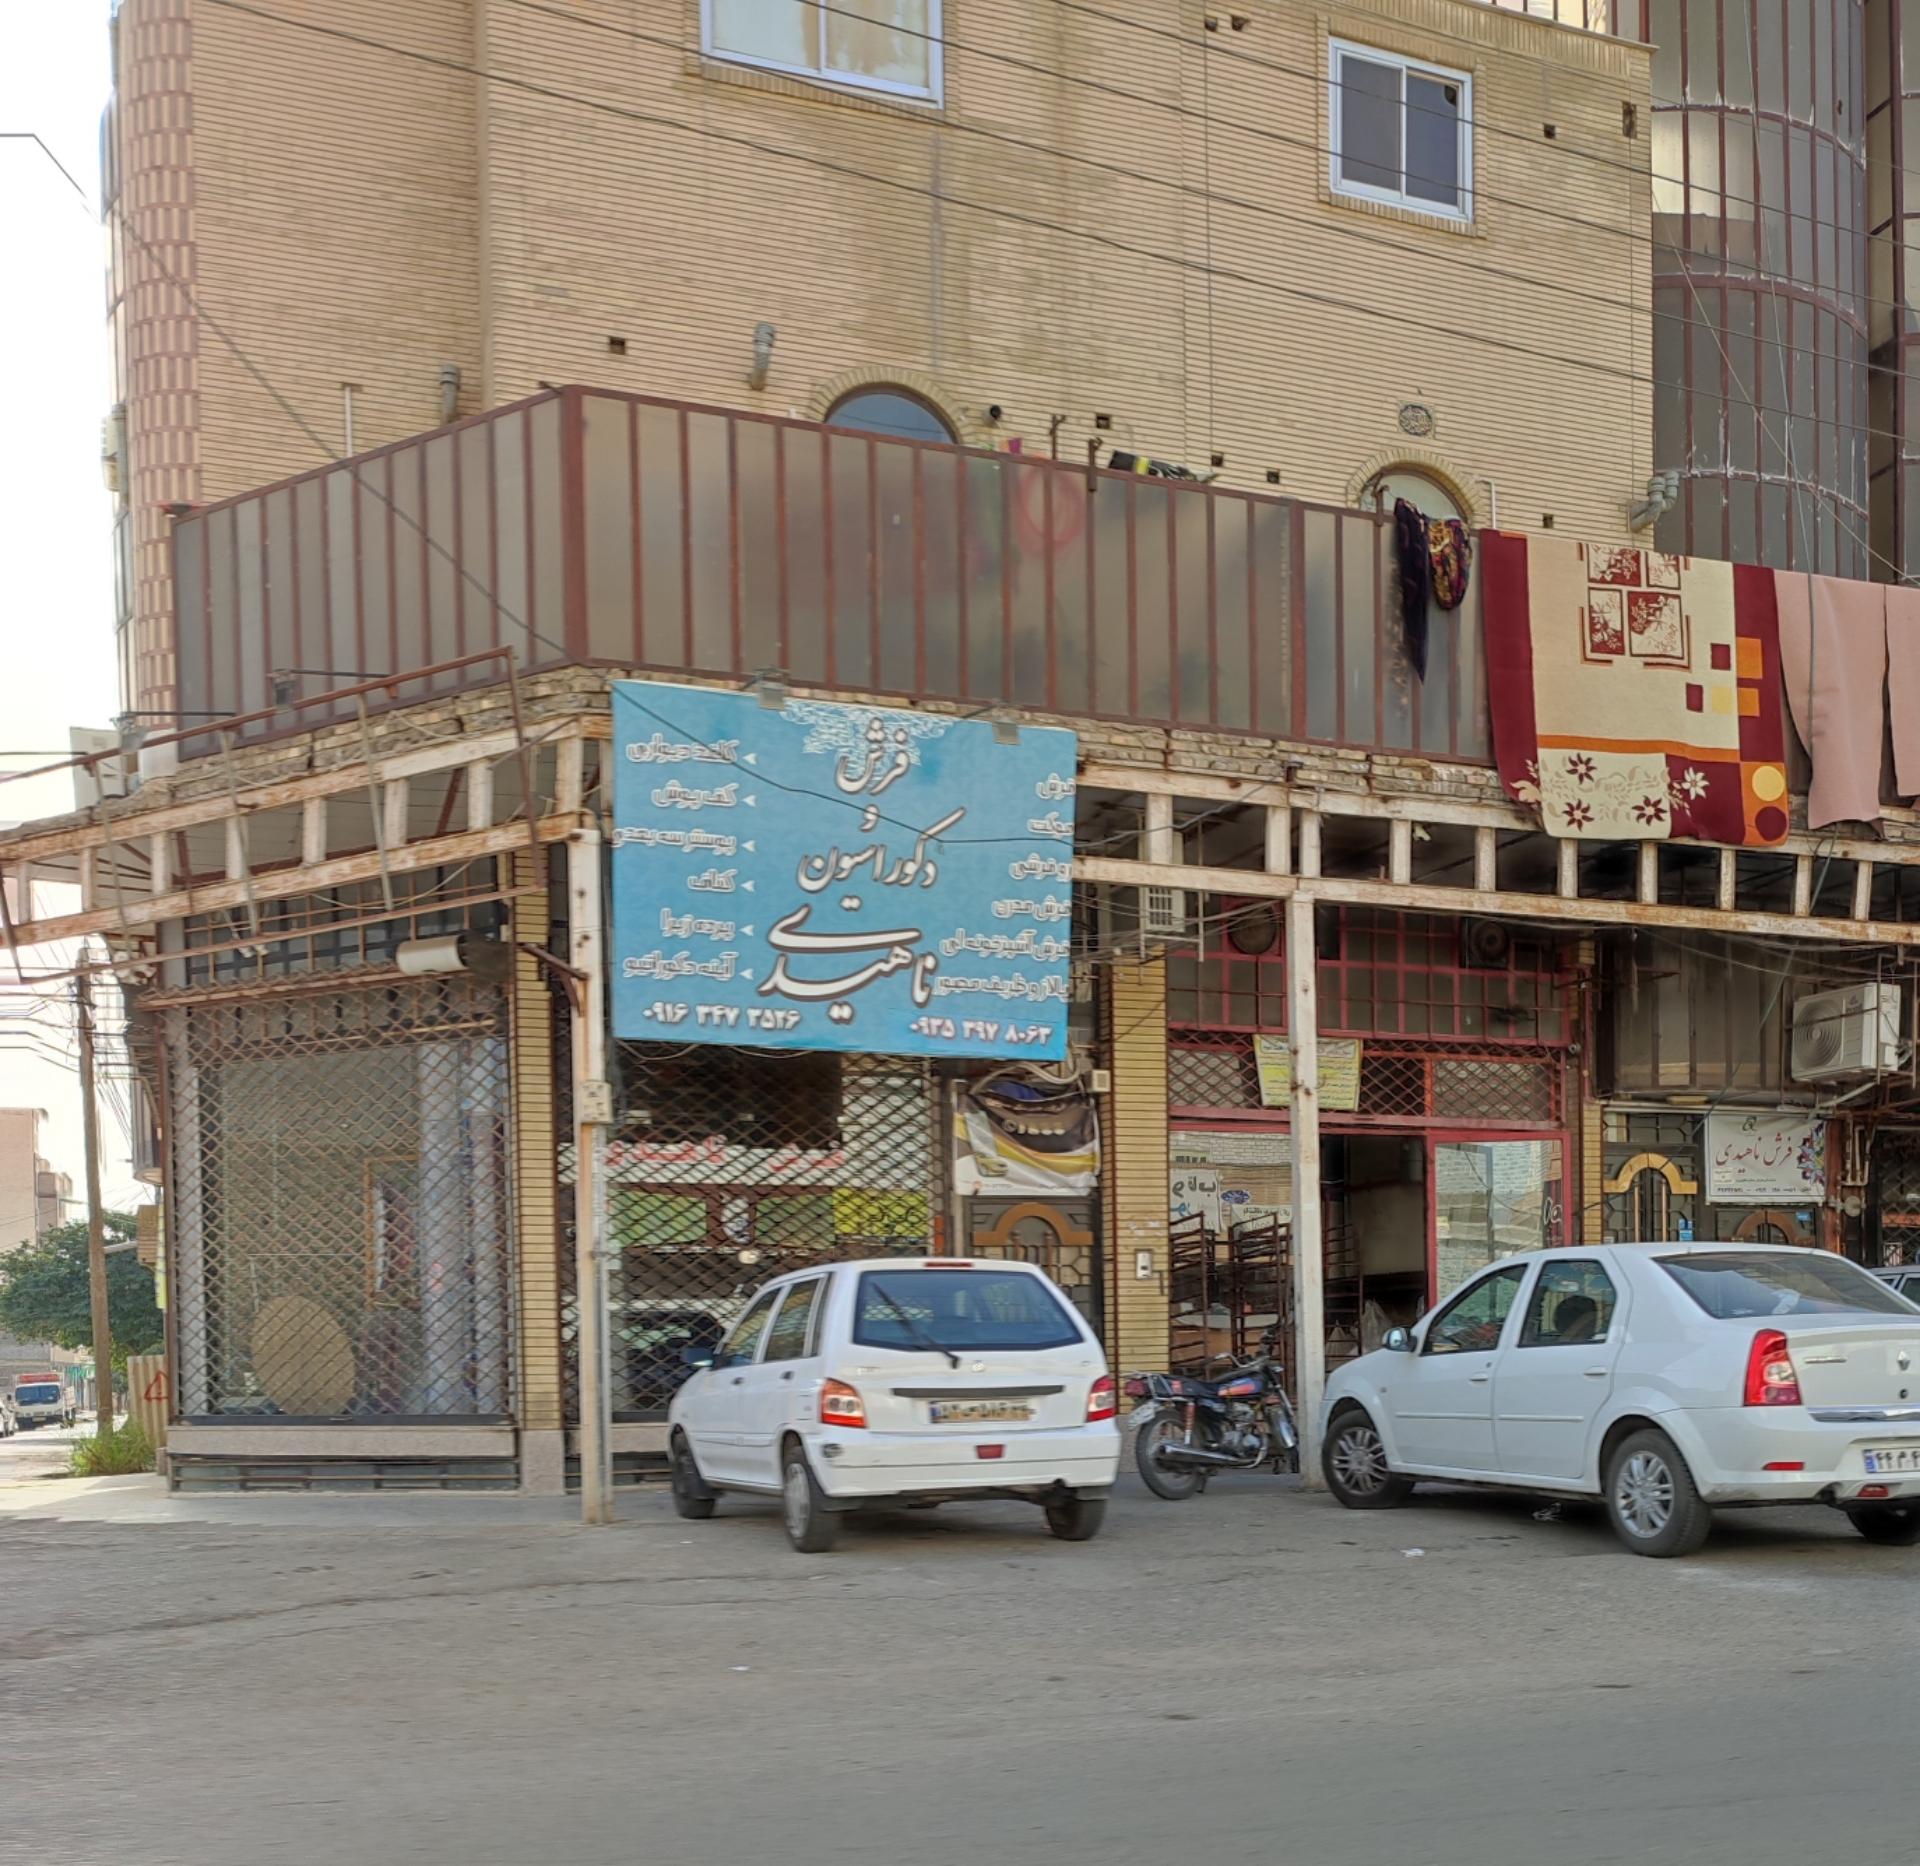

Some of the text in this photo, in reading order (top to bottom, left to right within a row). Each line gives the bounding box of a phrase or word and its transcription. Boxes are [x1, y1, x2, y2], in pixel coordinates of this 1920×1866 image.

[626, 733, 691, 764] دیواری
[836, 717, 910, 795] فرش
[858, 803, 881, 832] و
[796, 806, 967, 908] دکوراسیون
[756, 904, 938, 1024] ناهیدی
[642, 1001, 690, 1025] ۰۹۱۶
[1715, 1131, 1794, 1174] فرش ناهیدی
